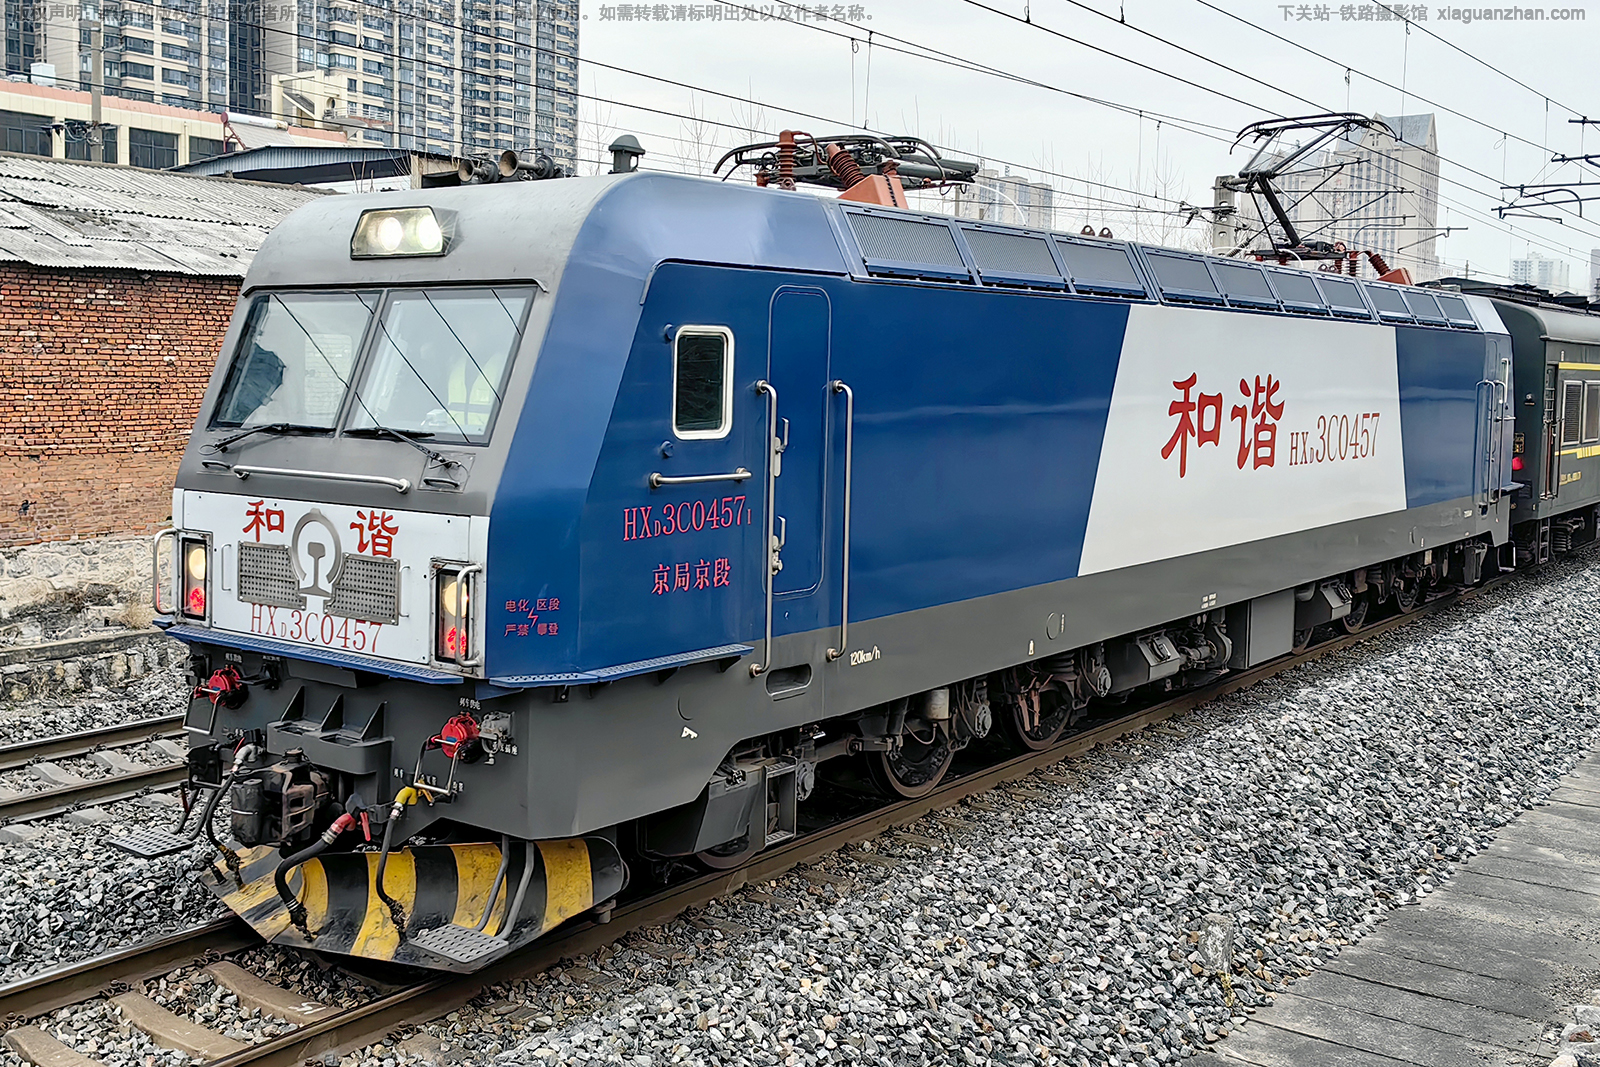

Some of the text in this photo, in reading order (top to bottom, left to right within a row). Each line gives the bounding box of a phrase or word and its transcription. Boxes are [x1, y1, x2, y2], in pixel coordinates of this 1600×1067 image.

[1161, 372, 1381, 479] 和谐 HXD3C0457
[242, 499, 400, 558] 和 谐
[651, 557, 732, 596] 京局京段
[250, 602, 383, 653] HXD3C0457
[849, 644, 881, 667] 120km/h
